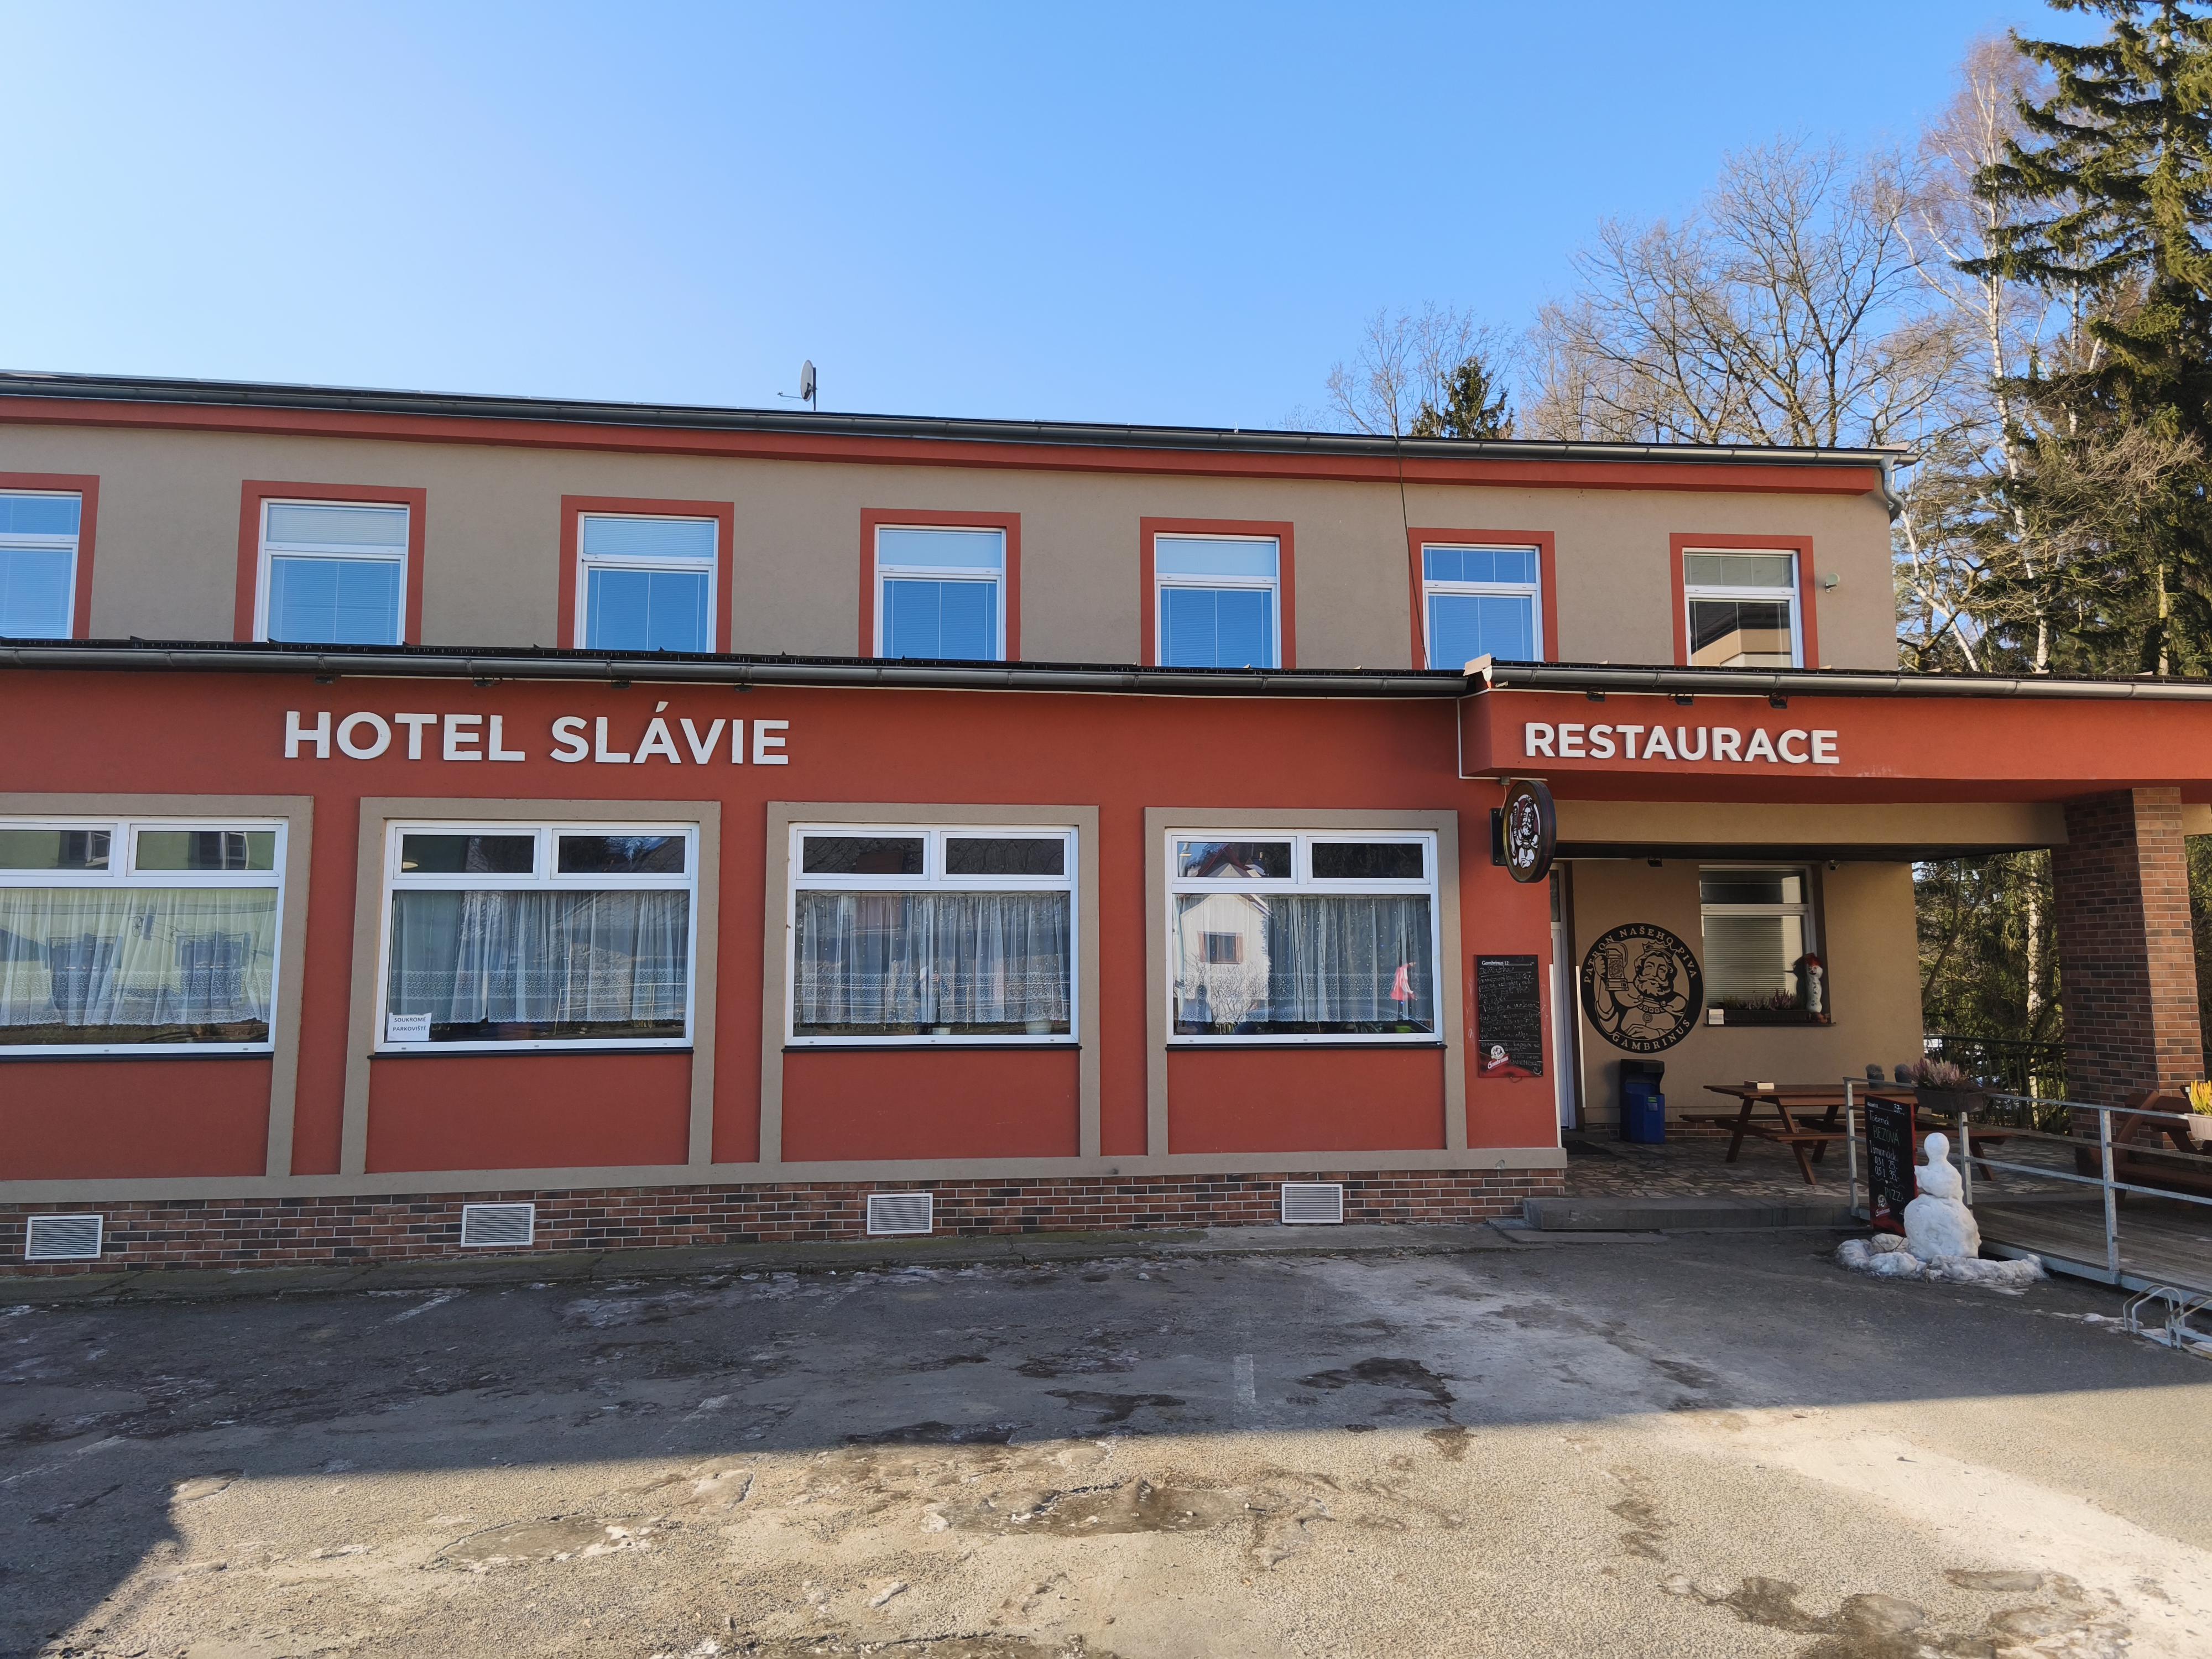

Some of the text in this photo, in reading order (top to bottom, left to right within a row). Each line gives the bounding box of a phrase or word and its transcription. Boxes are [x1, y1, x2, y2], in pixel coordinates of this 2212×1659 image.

[285, 701, 790, 765] HOTEL SLÁVIE
[1525, 722, 1840, 765] RESTAURACE
[1584, 926, 1698, 984] PATRON NAŠEHO PIVA
[1612, 1019, 1691, 1051] GAMBRINUS
